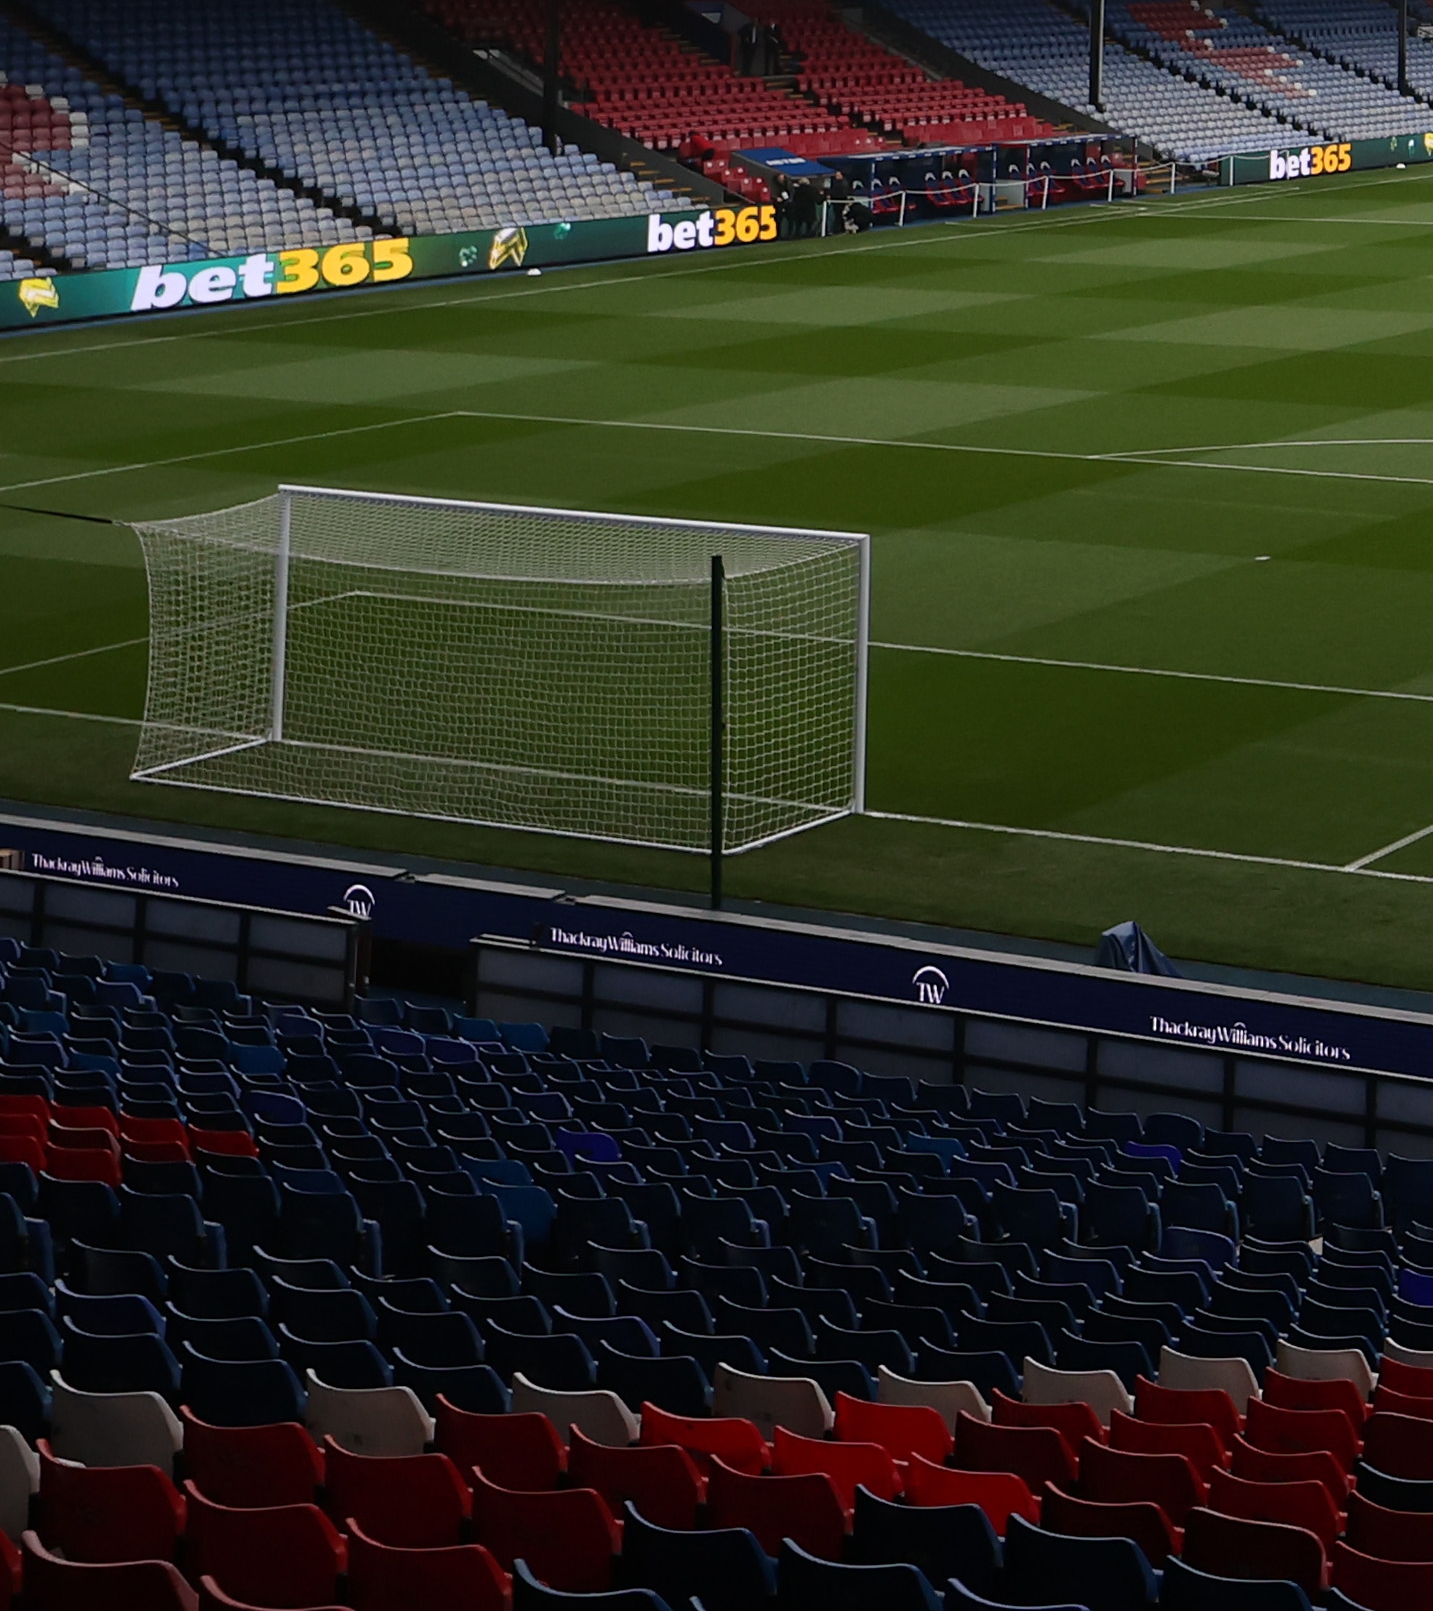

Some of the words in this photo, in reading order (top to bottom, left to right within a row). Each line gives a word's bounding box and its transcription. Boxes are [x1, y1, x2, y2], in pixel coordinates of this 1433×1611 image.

[1269, 144, 1352, 180] bet365
[646, 206, 777, 253] bet365
[130, 237, 414, 311] bet365
[660, 943, 723, 966] Solicitors
[1278, 1034, 1351, 1061] Solicitors
